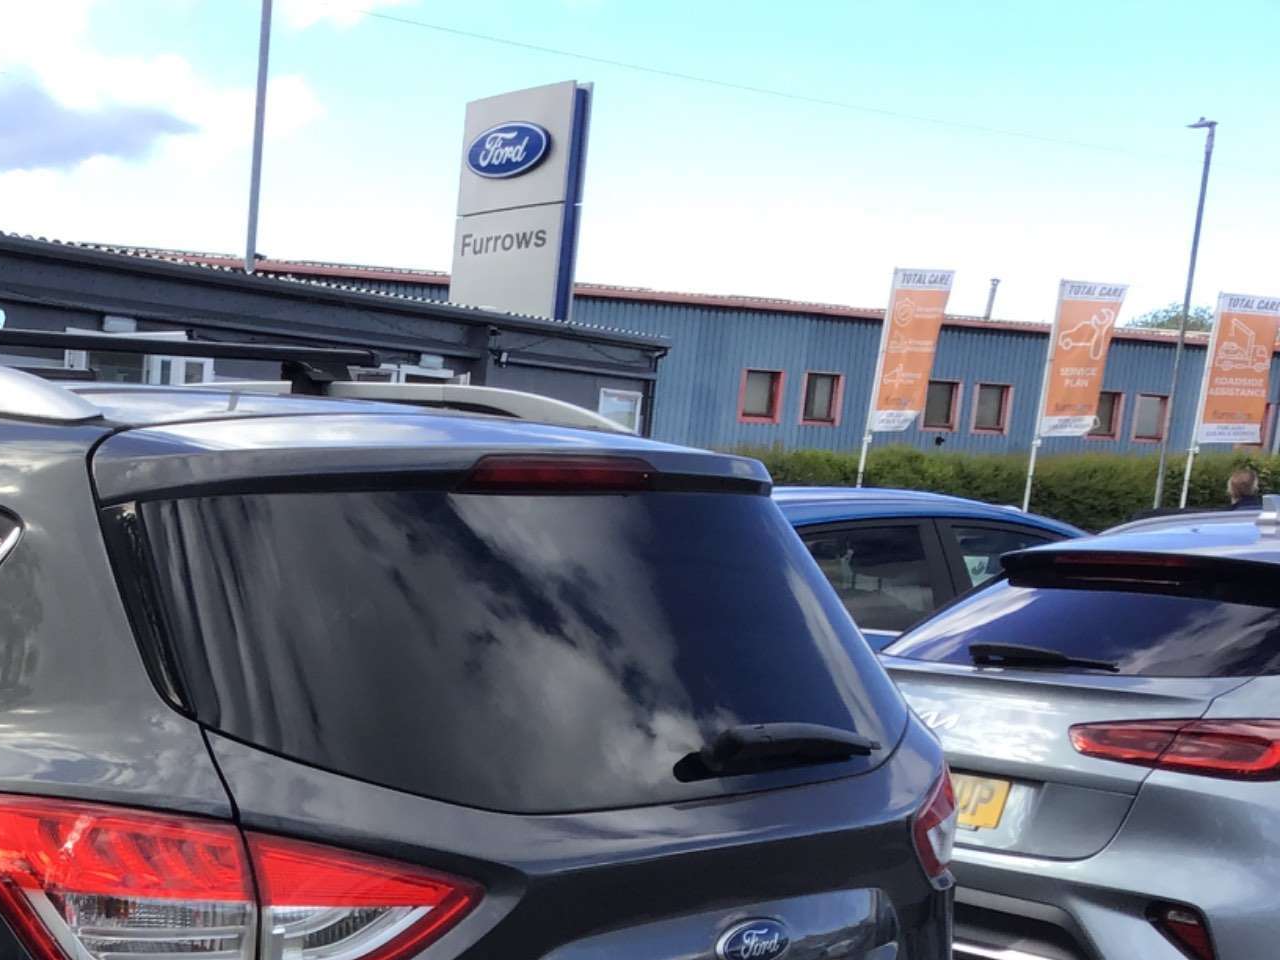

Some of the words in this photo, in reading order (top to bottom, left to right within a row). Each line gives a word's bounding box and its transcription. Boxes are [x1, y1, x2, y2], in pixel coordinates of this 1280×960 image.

[479, 131, 530, 168] Ford
[461, 229, 548, 257] Furrows
[901, 271, 926, 285] TOTAL
[928, 273, 951, 286] CARE
[1069, 285, 1097, 297] TOTAL
[1098, 286, 1126, 298] CARE
[1228, 297, 1254, 309] TOTAL
[1059, 367, 1097, 376] SERVICE
[1064, 378, 1089, 388] PLAN
[740, 927, 781, 960] Ford
